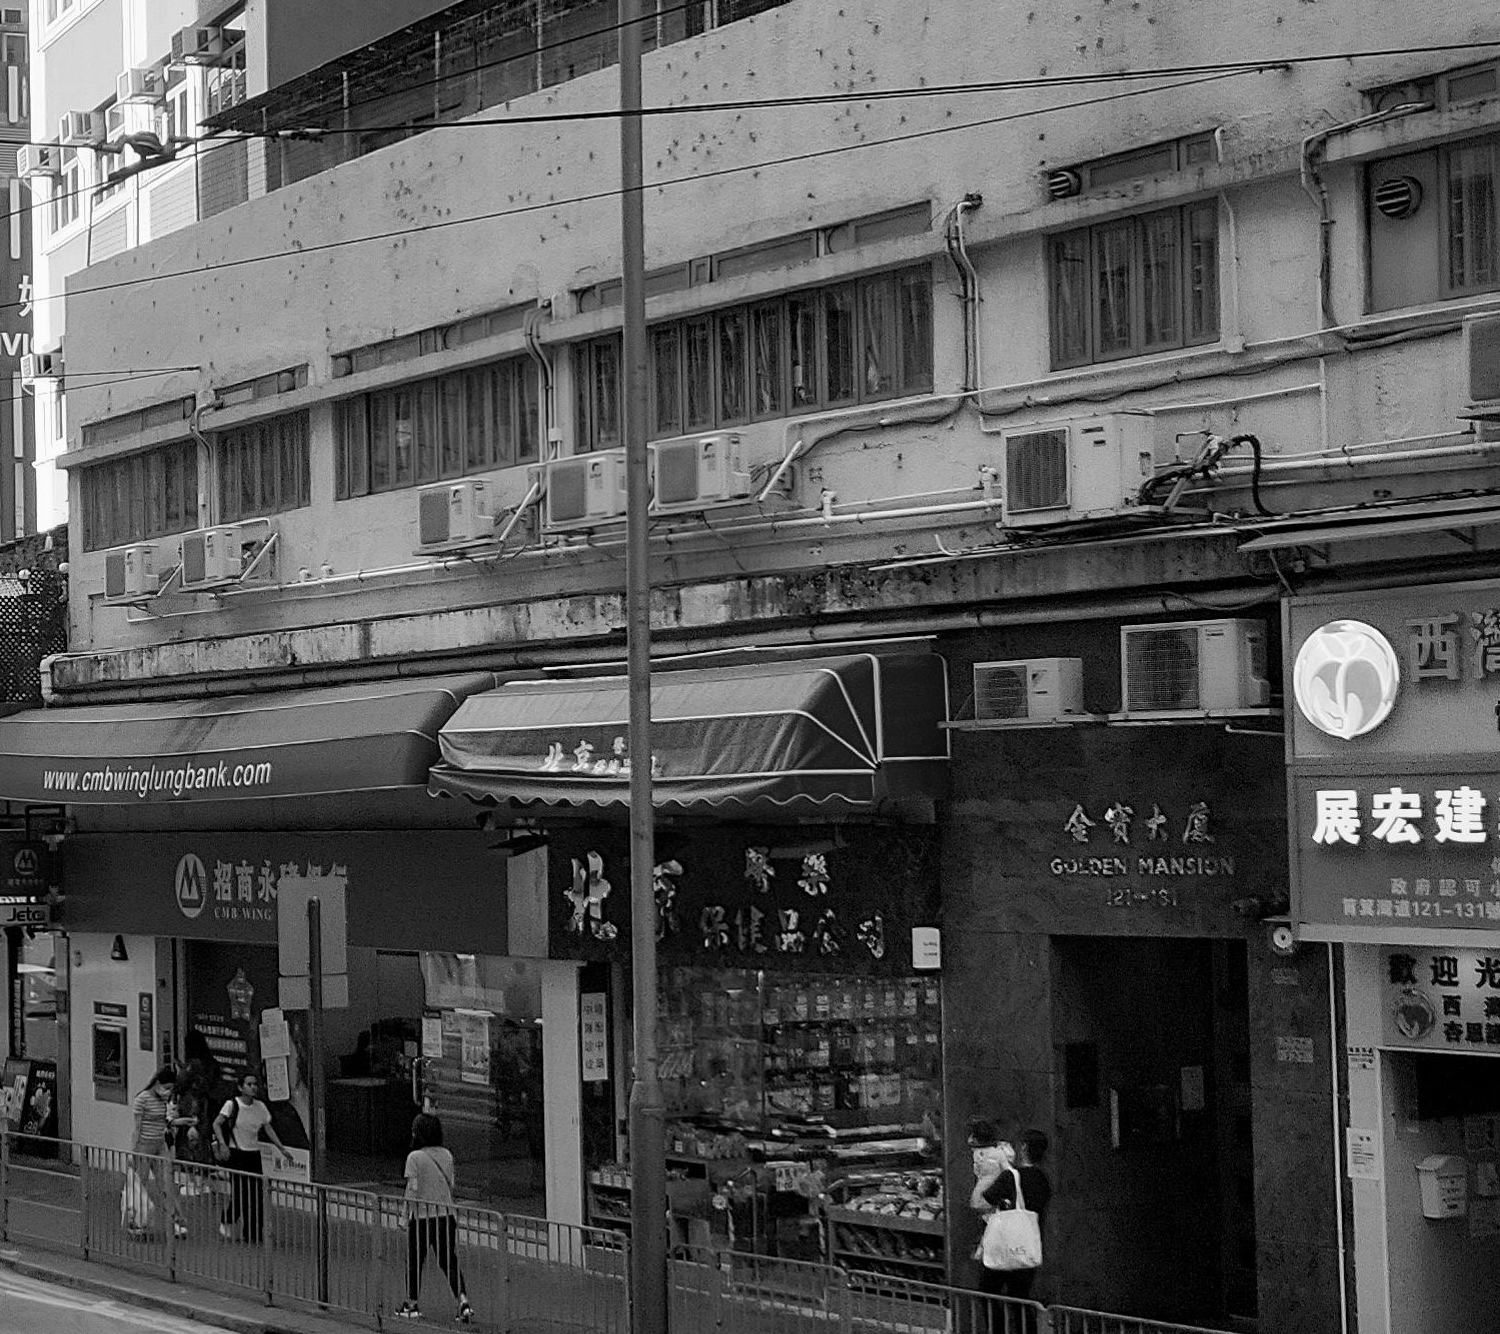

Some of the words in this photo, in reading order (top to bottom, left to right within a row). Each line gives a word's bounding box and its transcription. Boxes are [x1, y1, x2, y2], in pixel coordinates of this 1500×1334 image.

[43, 760, 272, 798] www.cmbwinglungbank.com
[1312, 786, 1500, 844] 展宏建
[1050, 858, 1127, 875] GOLDEN
[1138, 857, 1234, 875] MANSION
[242, 907, 272, 921] WING
